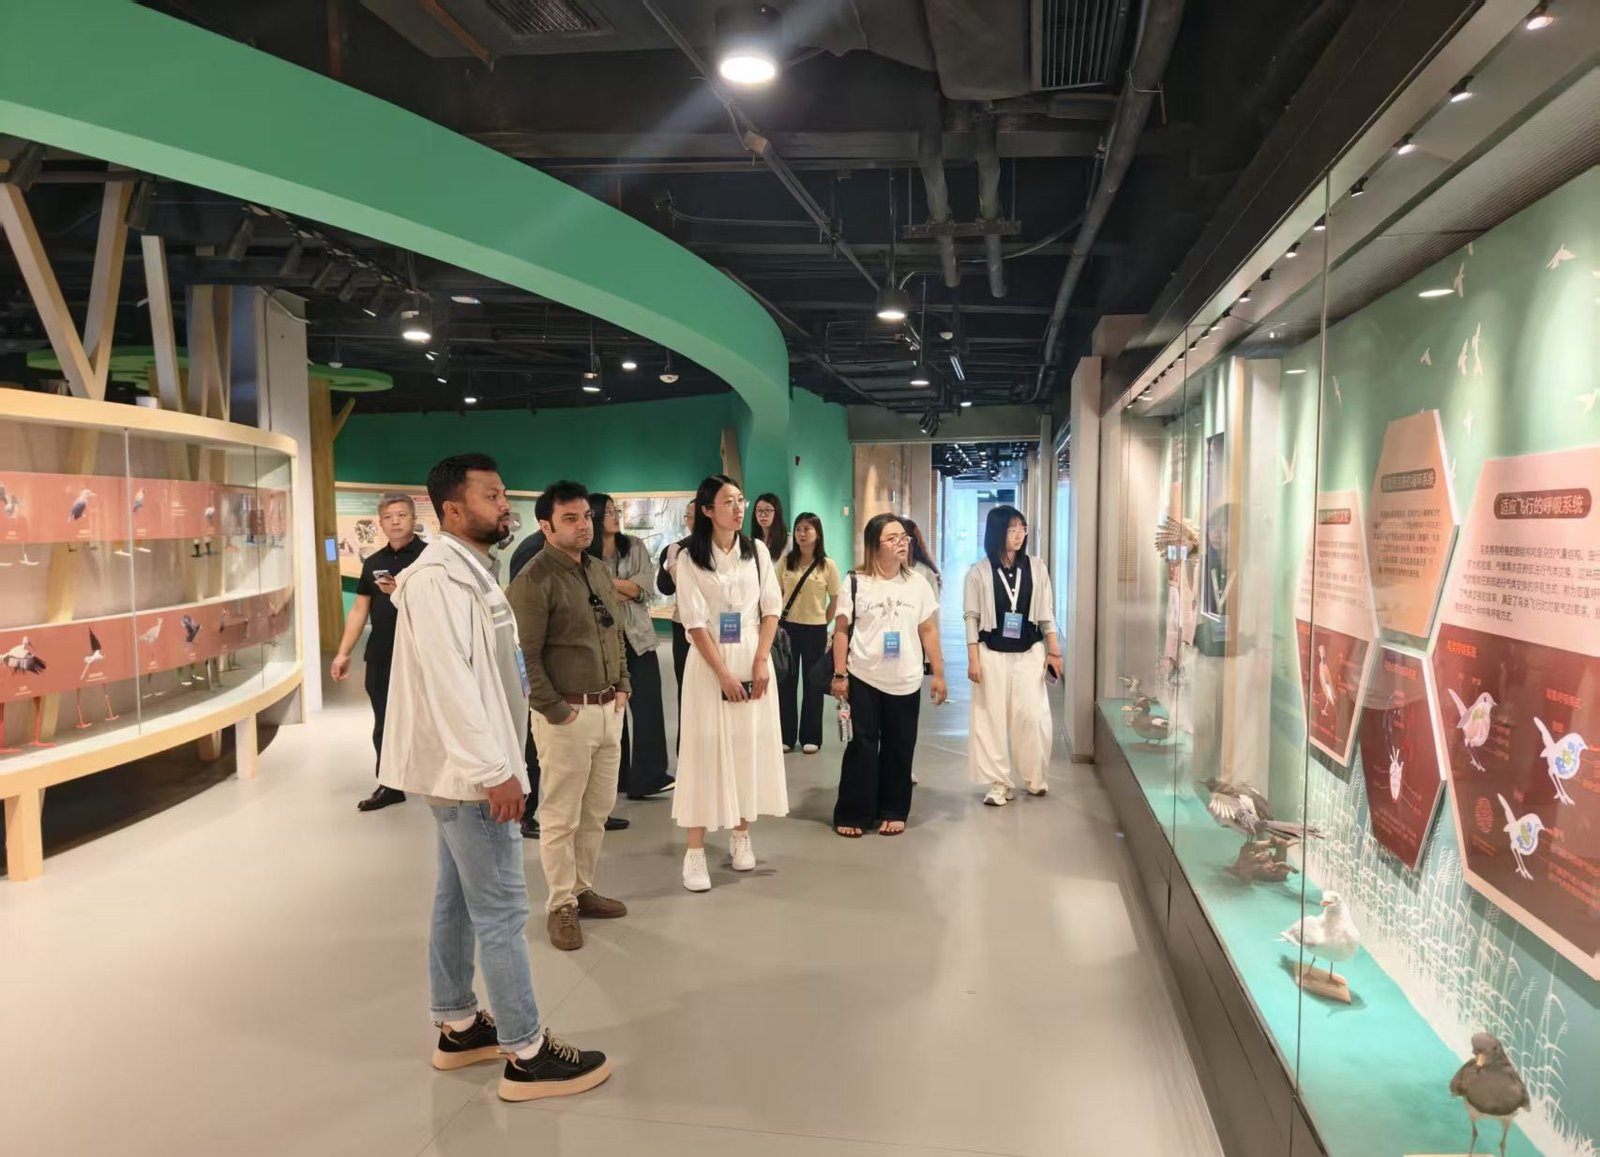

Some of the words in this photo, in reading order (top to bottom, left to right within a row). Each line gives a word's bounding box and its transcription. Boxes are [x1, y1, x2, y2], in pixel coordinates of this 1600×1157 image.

[1500, 495, 1584, 516] 适应飞行的呼吸系统
